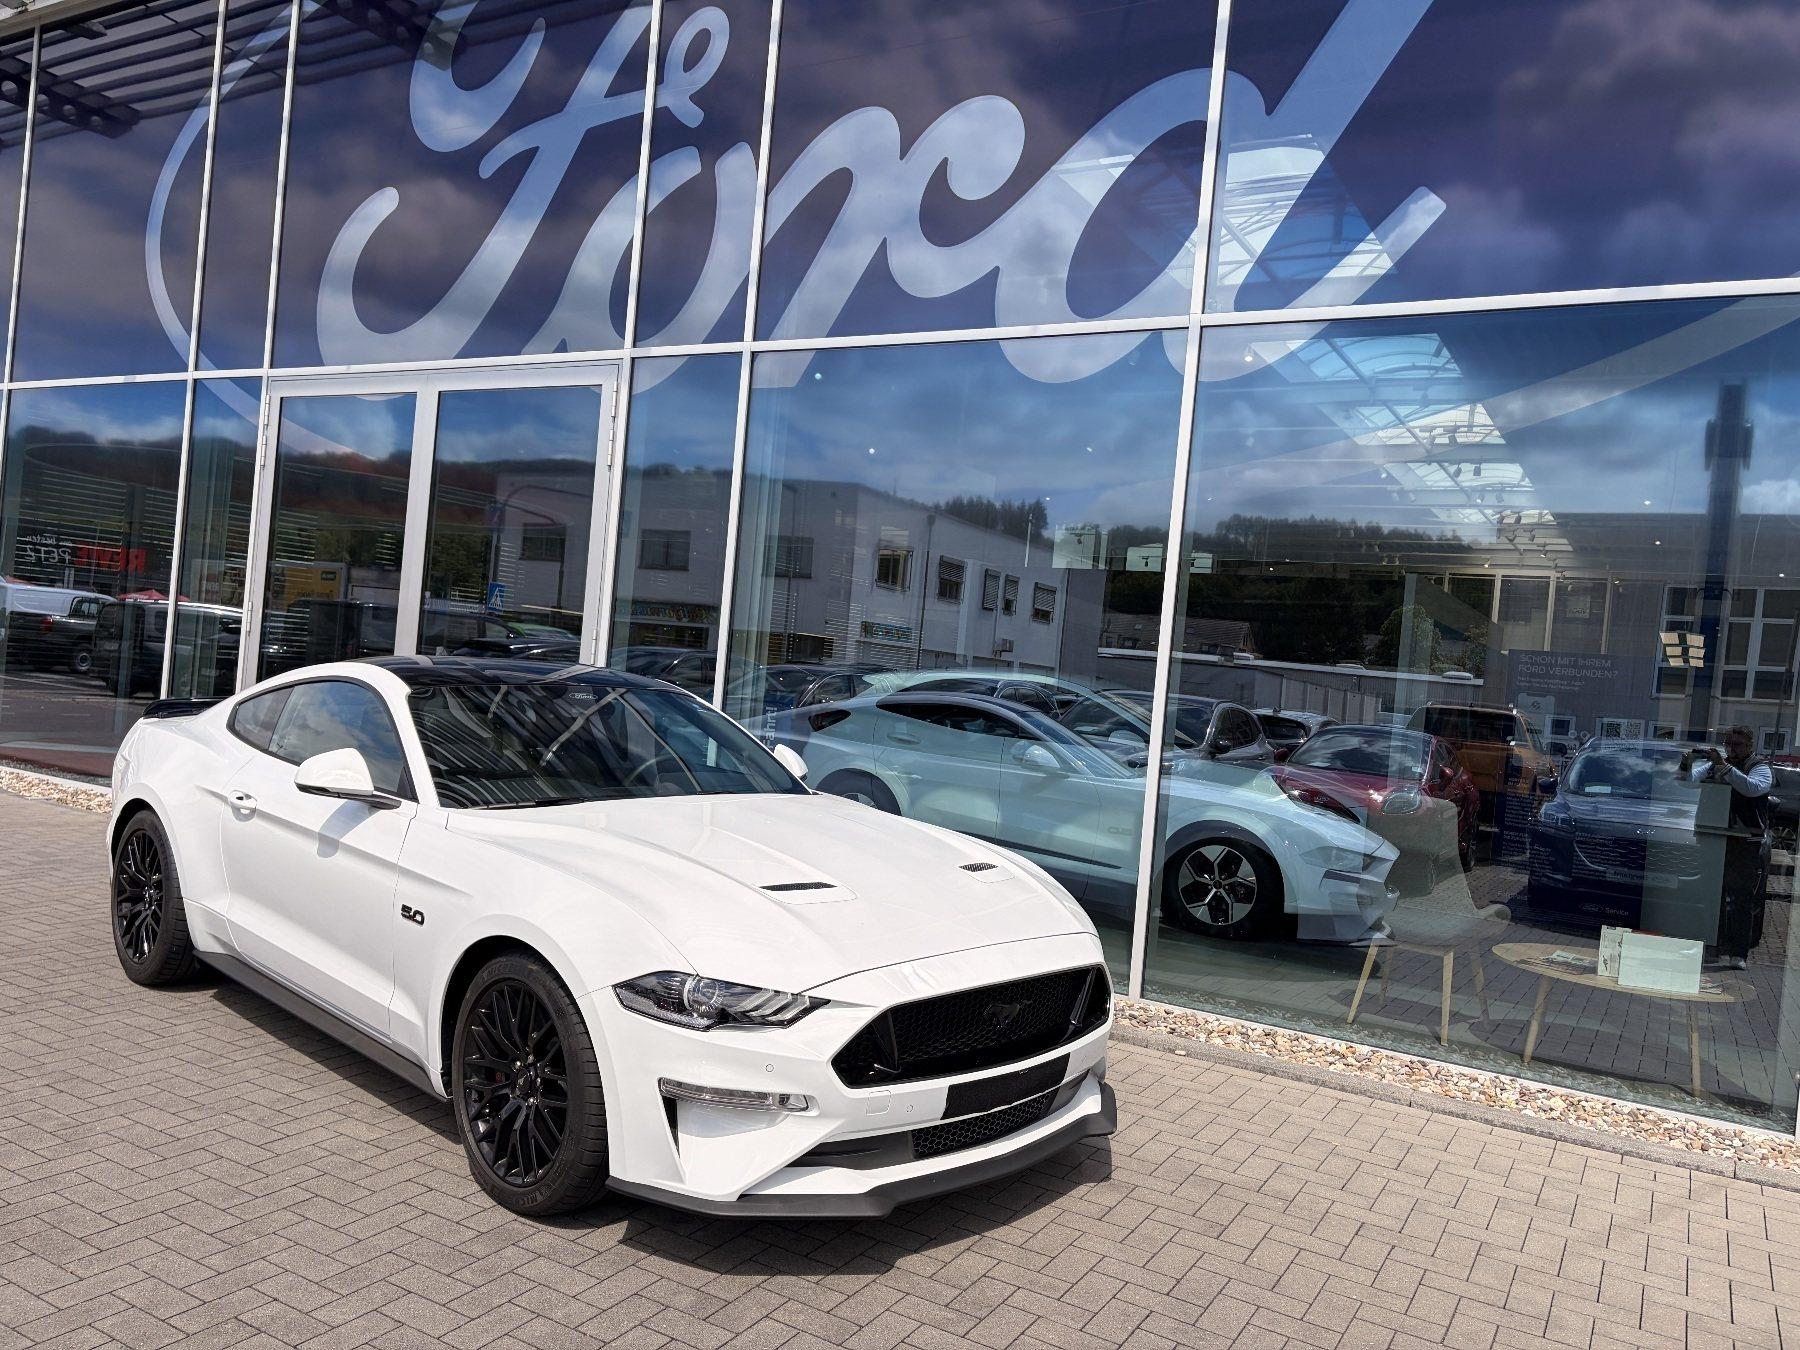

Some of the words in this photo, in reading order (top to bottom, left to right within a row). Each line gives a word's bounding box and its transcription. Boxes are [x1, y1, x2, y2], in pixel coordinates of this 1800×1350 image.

[317, 0, 1446, 401] Ford
[1519, 654, 1556, 665] SCHON
[1557, 656, 1577, 666] MIT
[1578, 657, 1611, 668] IHREM
[1518, 664, 1546, 674] FORD
[1548, 667, 1619, 679] VERBUNDEN?
[1605, 907, 1630, 916] Service
